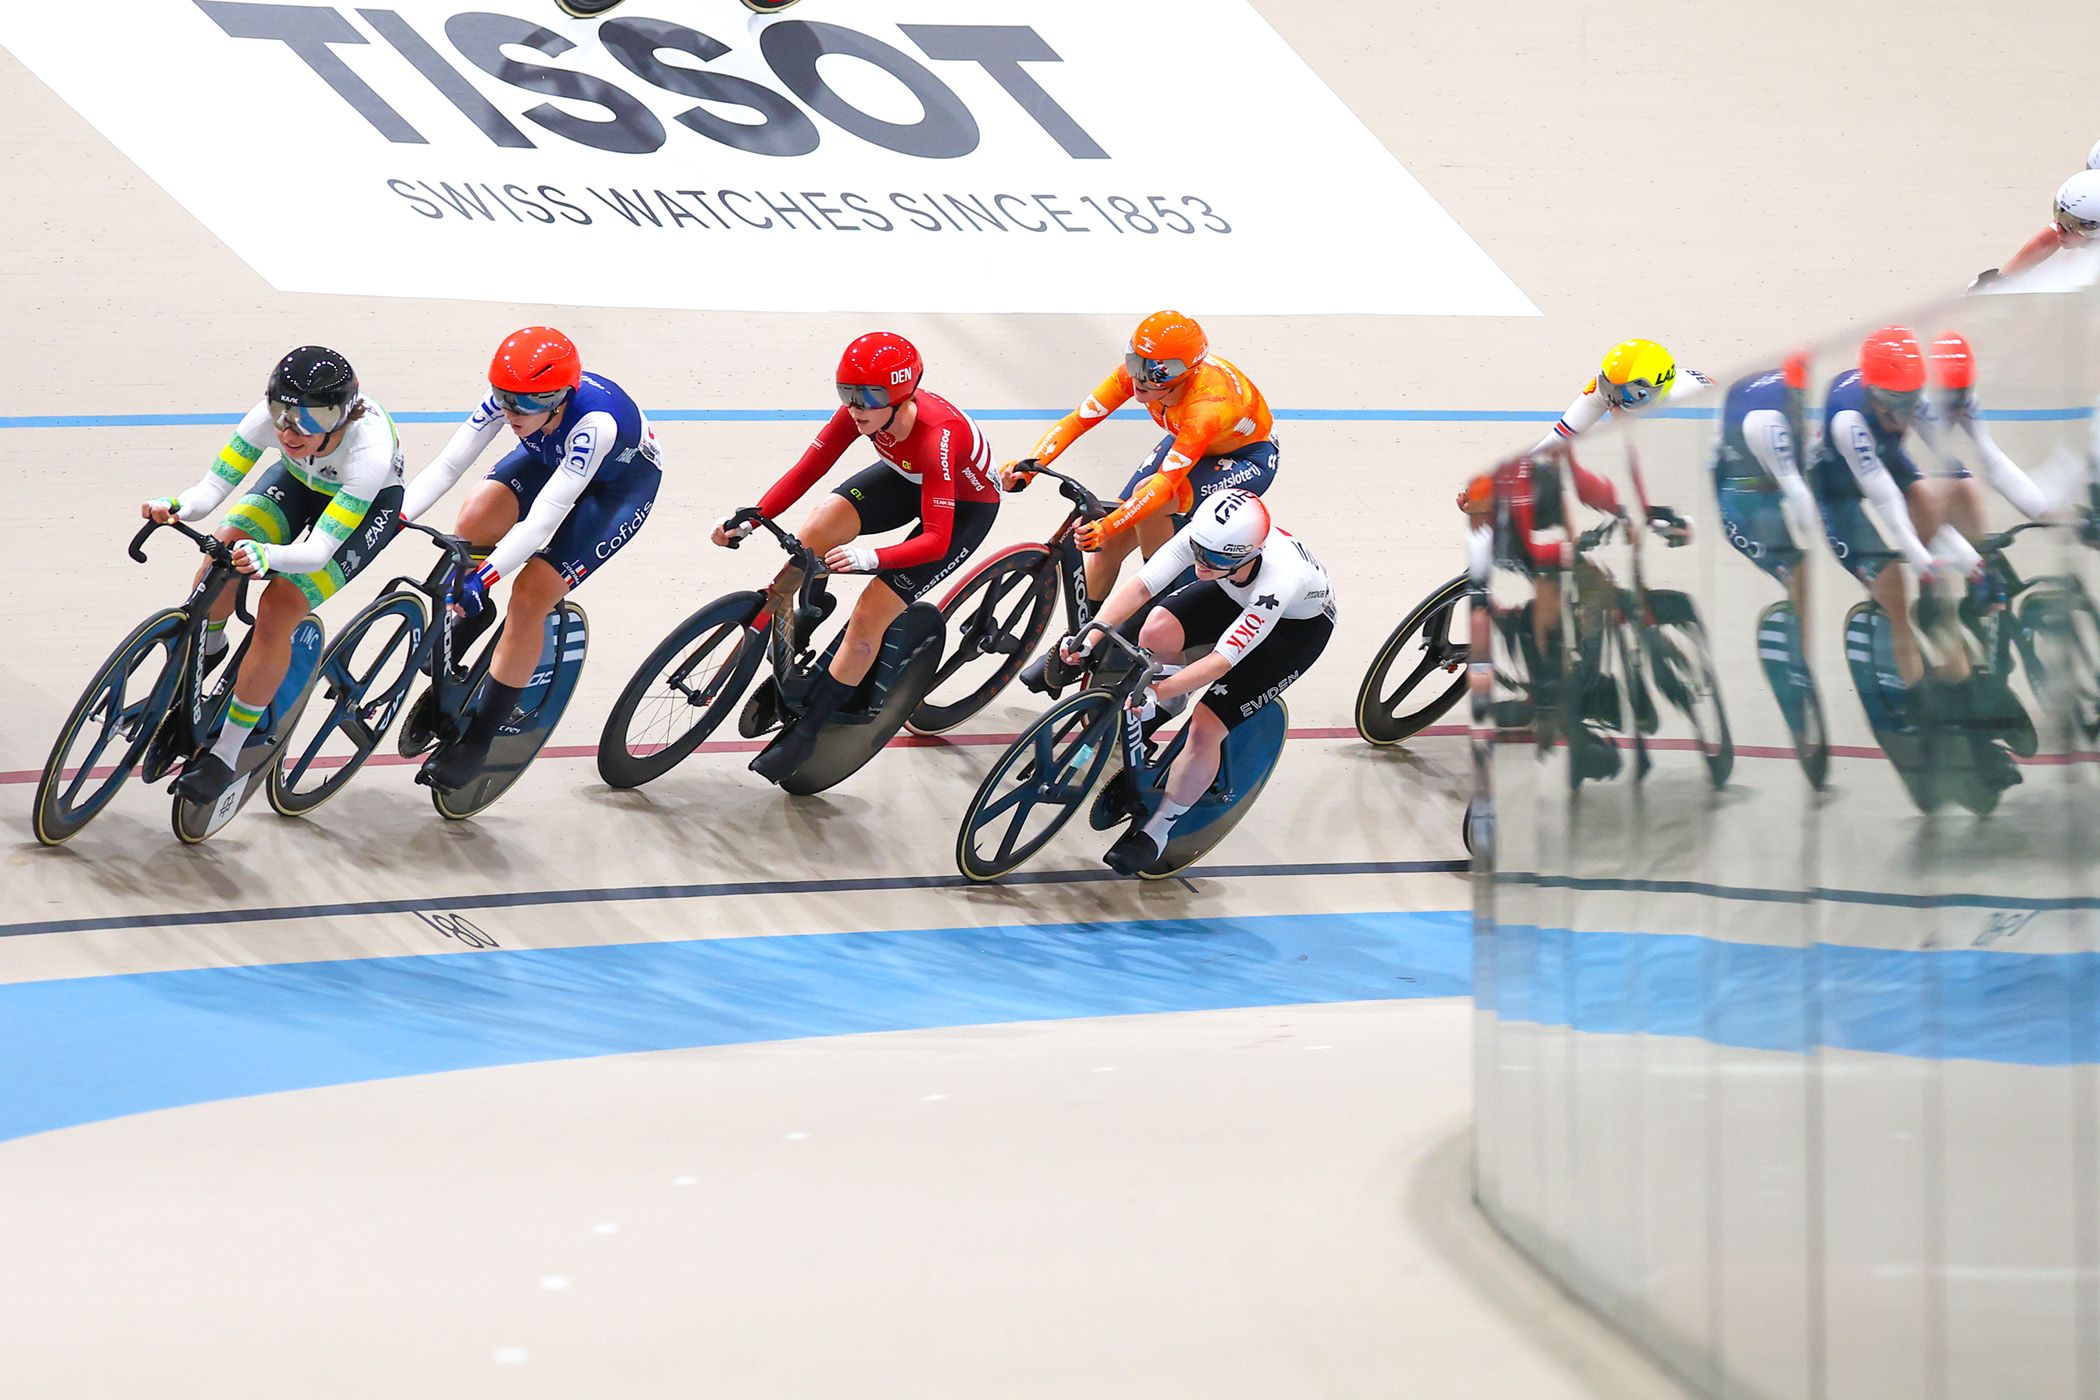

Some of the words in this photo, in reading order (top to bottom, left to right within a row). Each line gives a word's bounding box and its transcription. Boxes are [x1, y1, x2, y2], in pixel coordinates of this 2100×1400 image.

[192, 0, 1112, 160] TISSOT
[387, 178, 593, 226] SWISS
[586, 186, 893, 232] WATCHES
[889, 191, 1091, 233] SINCE
[1081, 194, 1232, 235] 1853
[890, 367, 912, 386] DEN
[1655, 364, 1675, 385] LAZ
[281, 394, 299, 404] KASK
[570, 432, 592, 470] CIC
[940, 427, 951, 481] postnord
[961, 466, 985, 492] postnord
[1201, 461, 1261, 497] Staatsloterij
[370, 509, 394, 541] ARA
[1112, 489, 1158, 529] Staatsloterij
[1214, 490, 1256, 526] GIR
[595, 500, 653, 559] Cofidis
[1223, 543, 1254, 553] GIRO
[914, 547, 970, 600] postnord
[1073, 564, 1090, 630] KOG
[300, 625, 319, 650] INC
[444, 609, 456, 677] OOK
[1240, 670, 1299, 718] EVIDEN
[412, 911, 500, 948] 180
